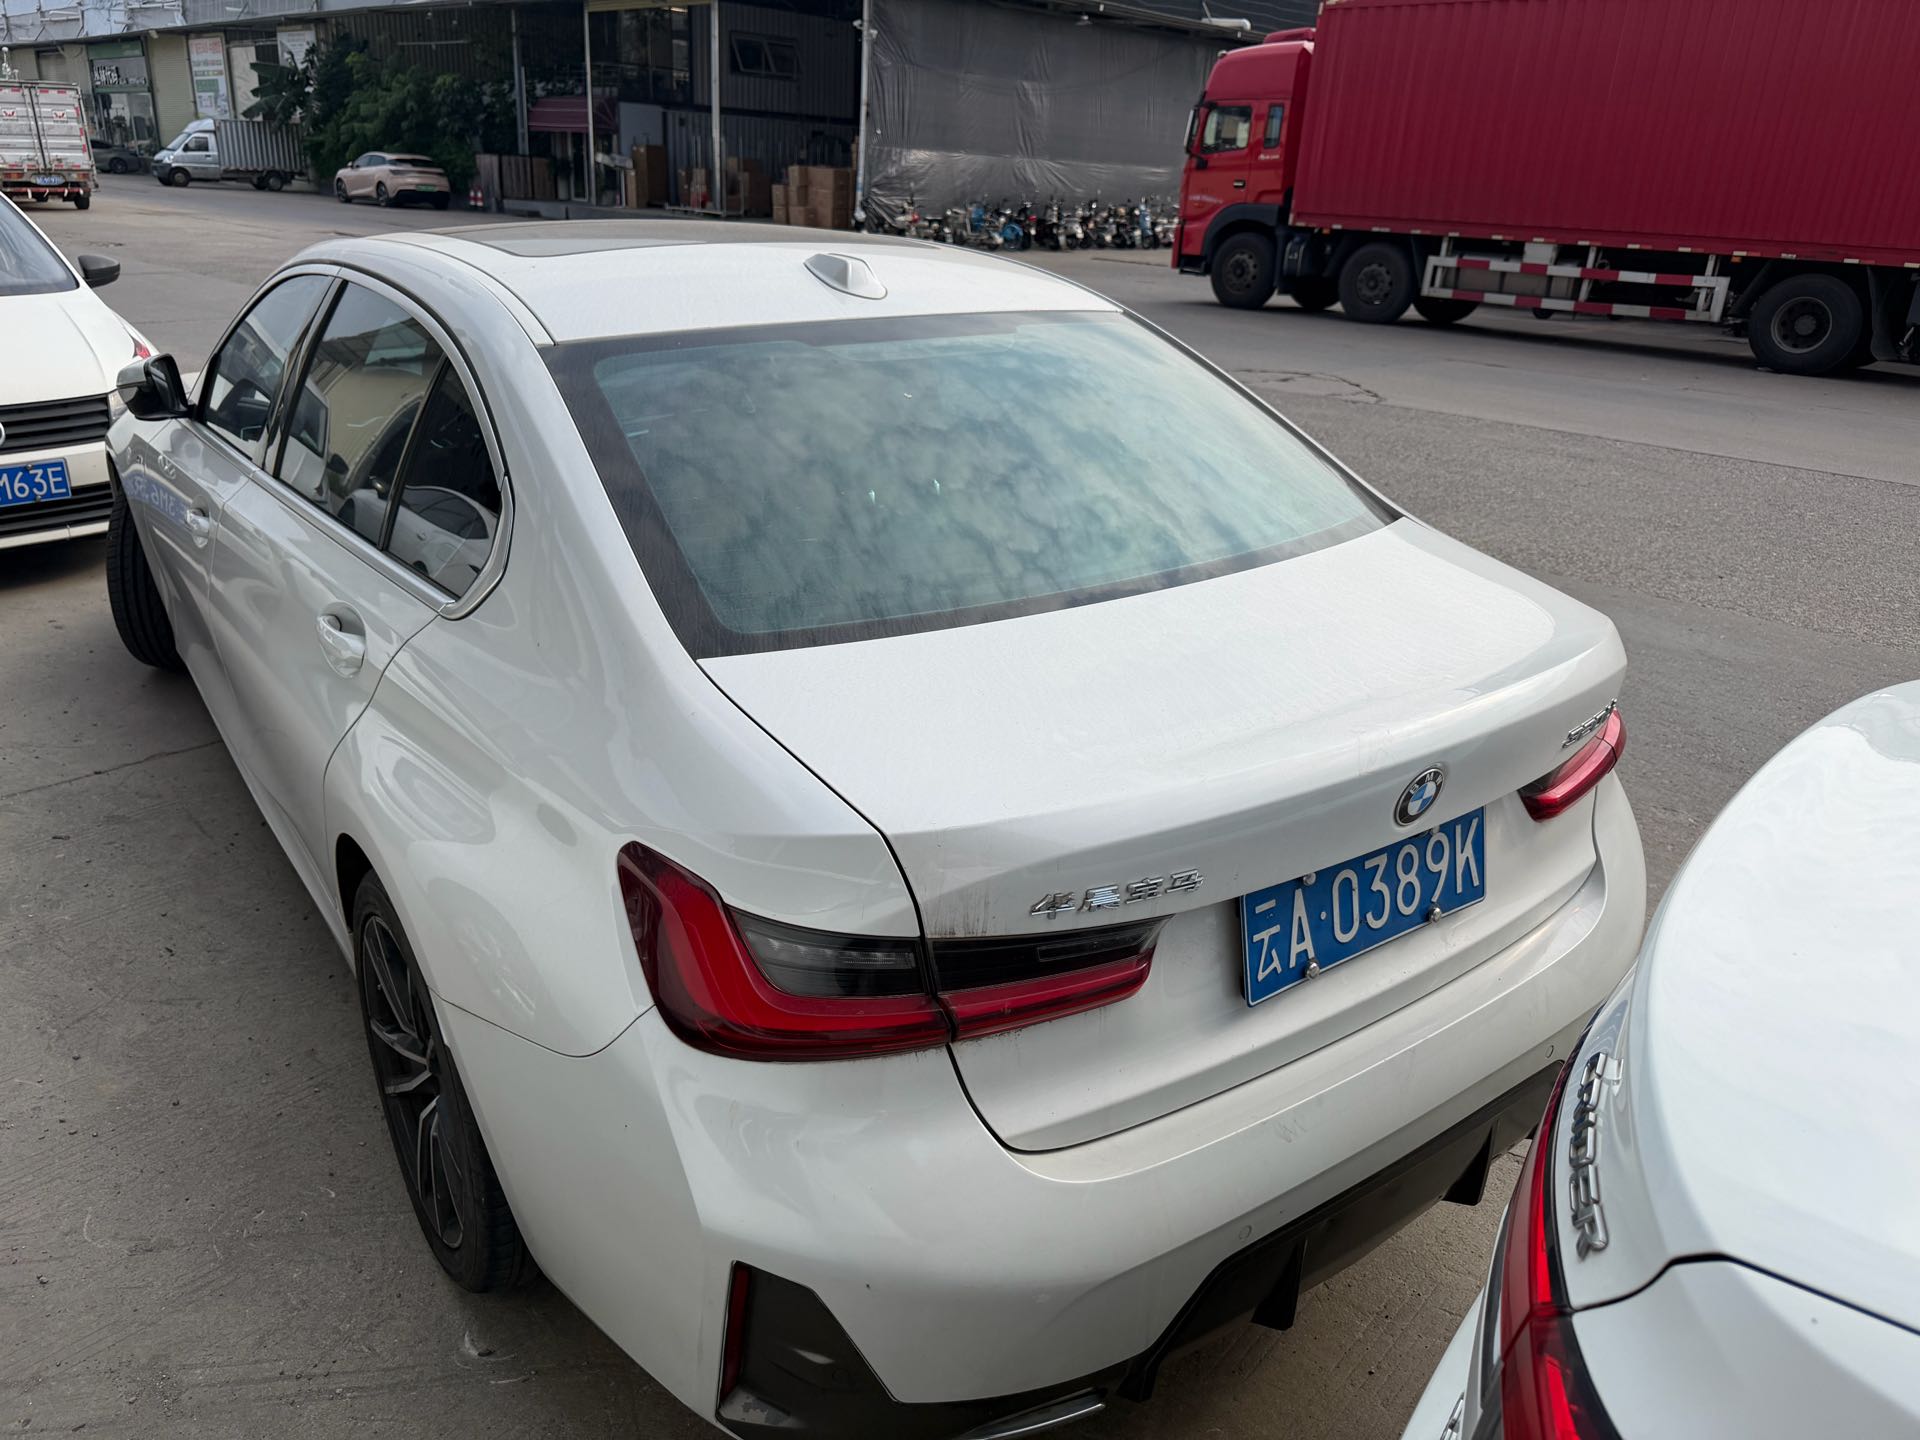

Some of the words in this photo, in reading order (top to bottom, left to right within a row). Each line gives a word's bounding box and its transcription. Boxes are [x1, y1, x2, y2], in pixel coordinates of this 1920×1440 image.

[1409, 771, 1443, 795] BMW
[1029, 868, 1205, 920] 华晨宝马
[1568, 1051, 1610, 1263] CRIDER
